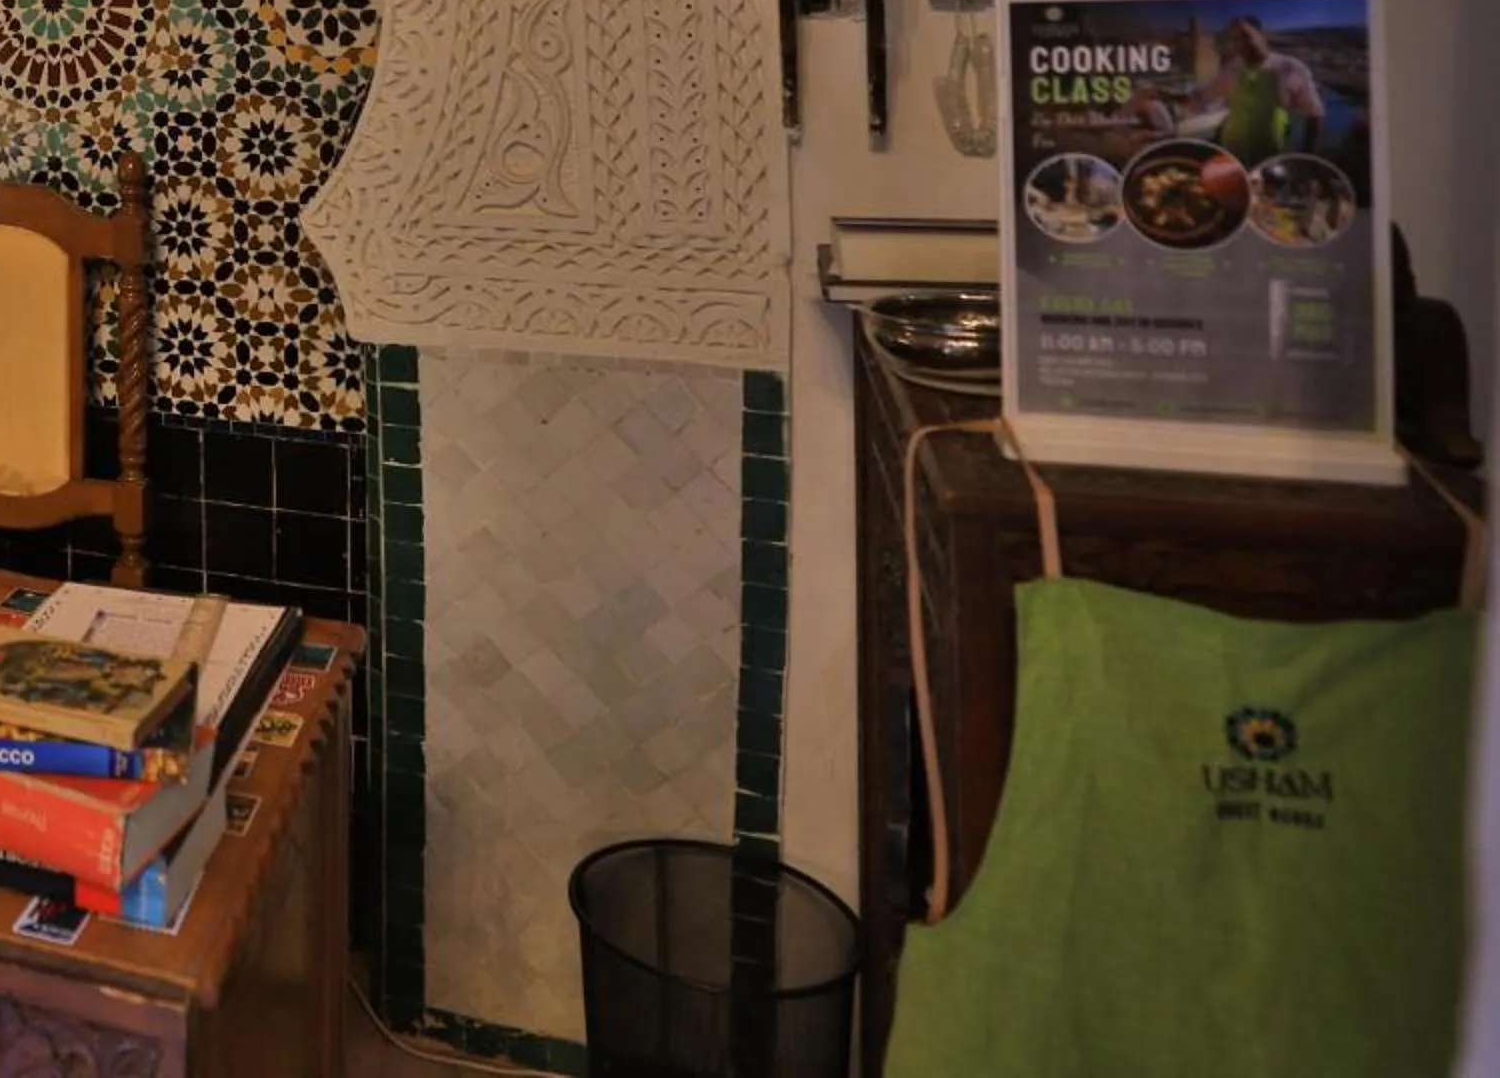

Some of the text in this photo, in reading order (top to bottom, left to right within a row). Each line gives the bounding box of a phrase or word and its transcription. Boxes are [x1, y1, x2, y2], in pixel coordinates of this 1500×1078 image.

[1030, 44, 1172, 74] COOKING
[1031, 75, 1132, 105] CLASS
[1201, 764, 1333, 799] USHAM
